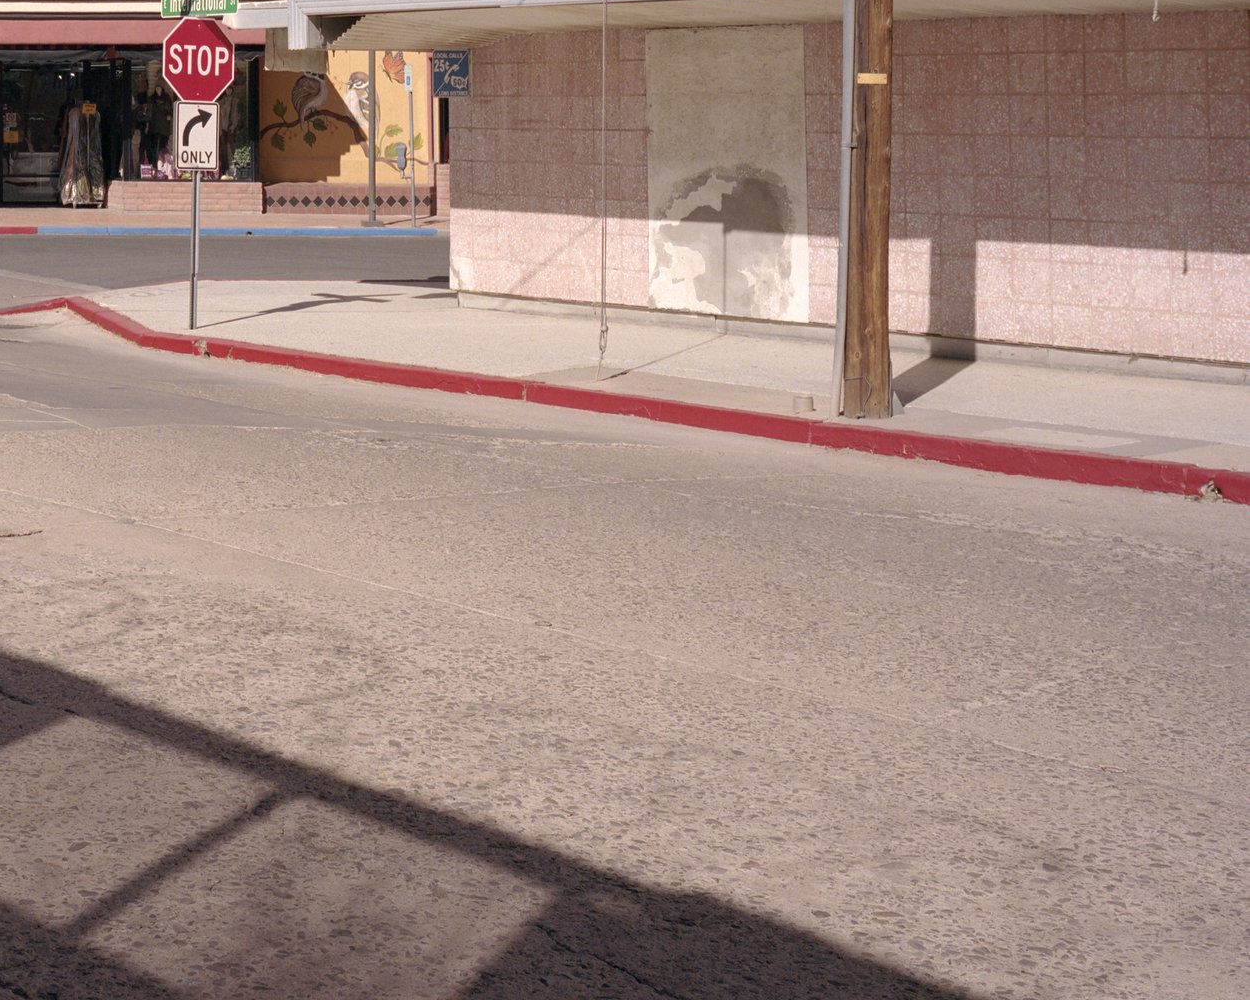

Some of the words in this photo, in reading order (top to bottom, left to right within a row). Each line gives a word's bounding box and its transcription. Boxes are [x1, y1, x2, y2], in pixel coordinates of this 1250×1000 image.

[163, 0, 167, 9] E
[168, 43, 230, 77] STOP
[434, 59, 450, 72] 25¢
[180, 150, 213, 164] ONLY
